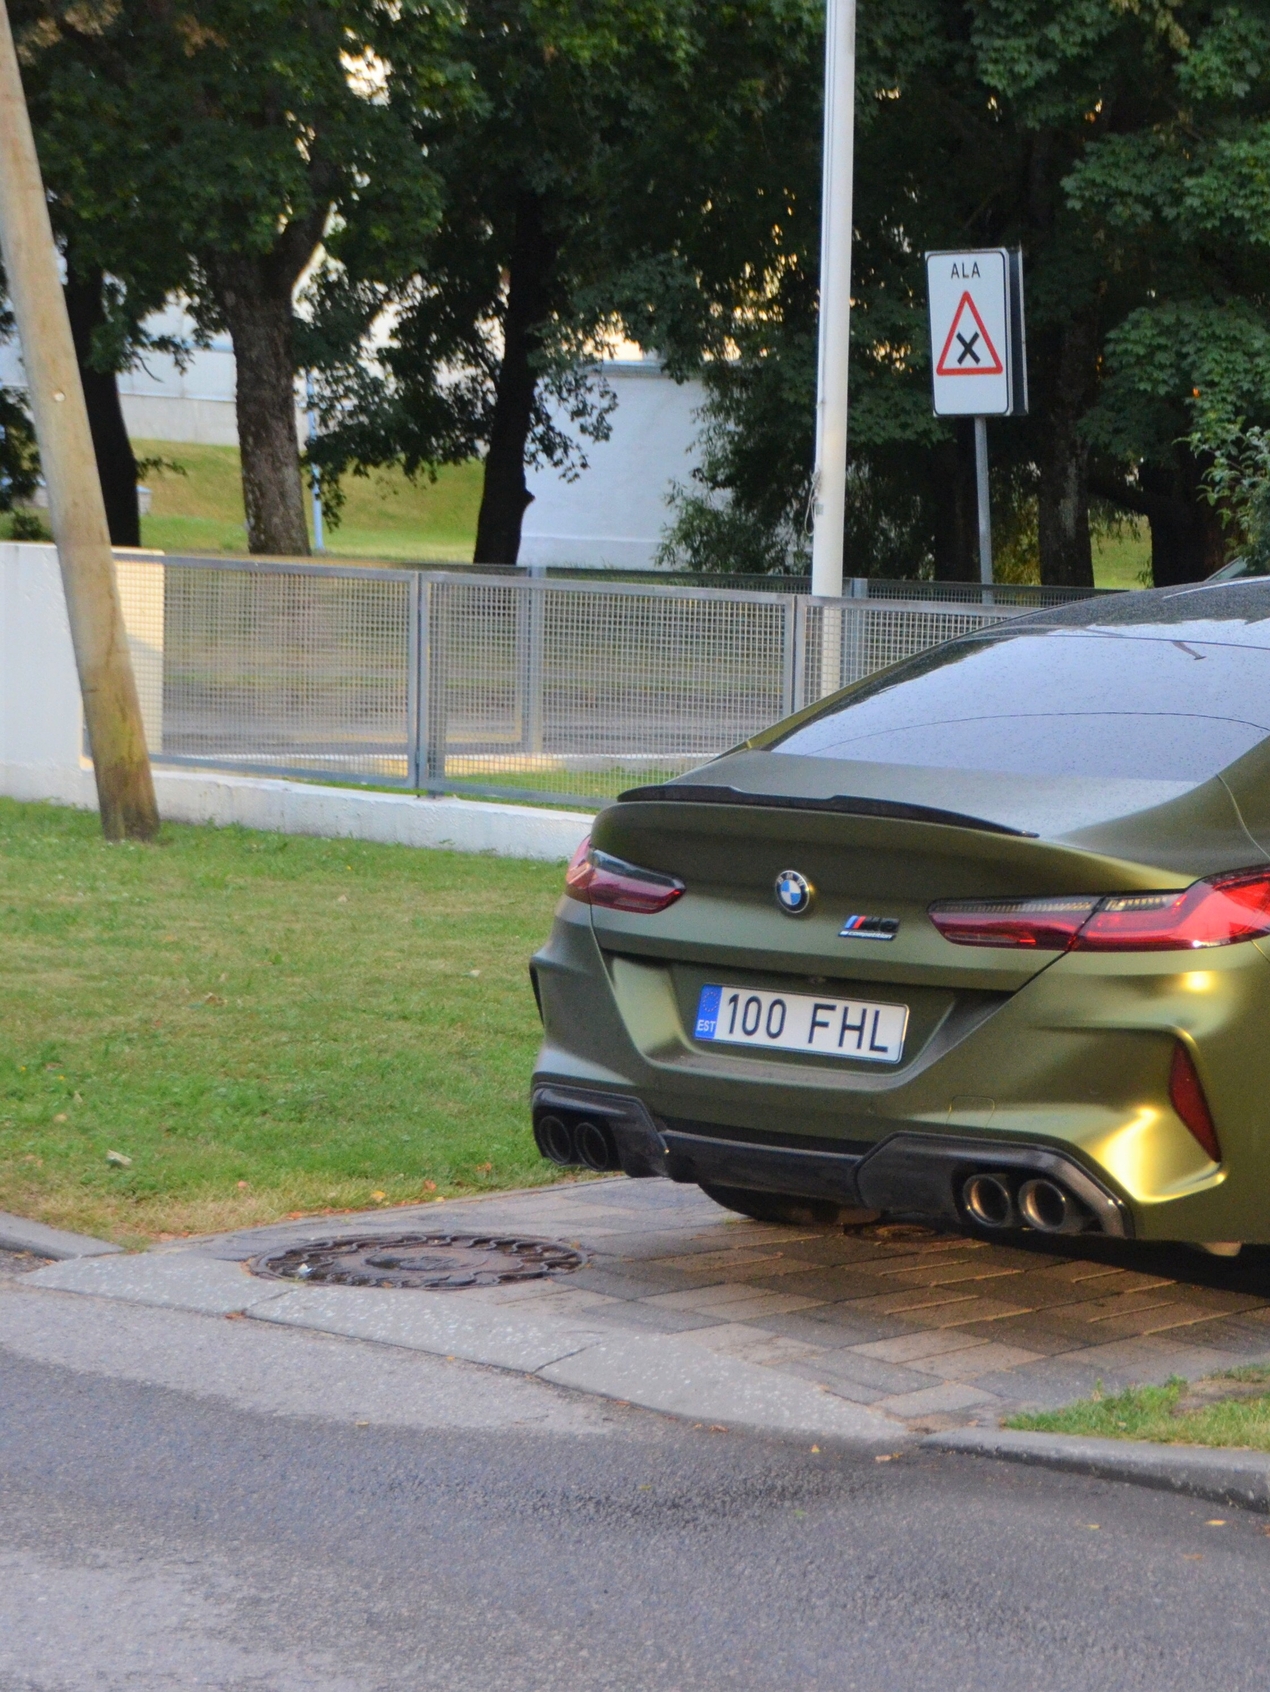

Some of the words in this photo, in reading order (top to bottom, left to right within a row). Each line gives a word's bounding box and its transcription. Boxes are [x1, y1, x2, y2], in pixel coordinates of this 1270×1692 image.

[951, 262, 981, 279] ALA
[696, 1019, 716, 1033] EST
[728, 994, 787, 1040] 100
[808, 1003, 889, 1053] FHL
